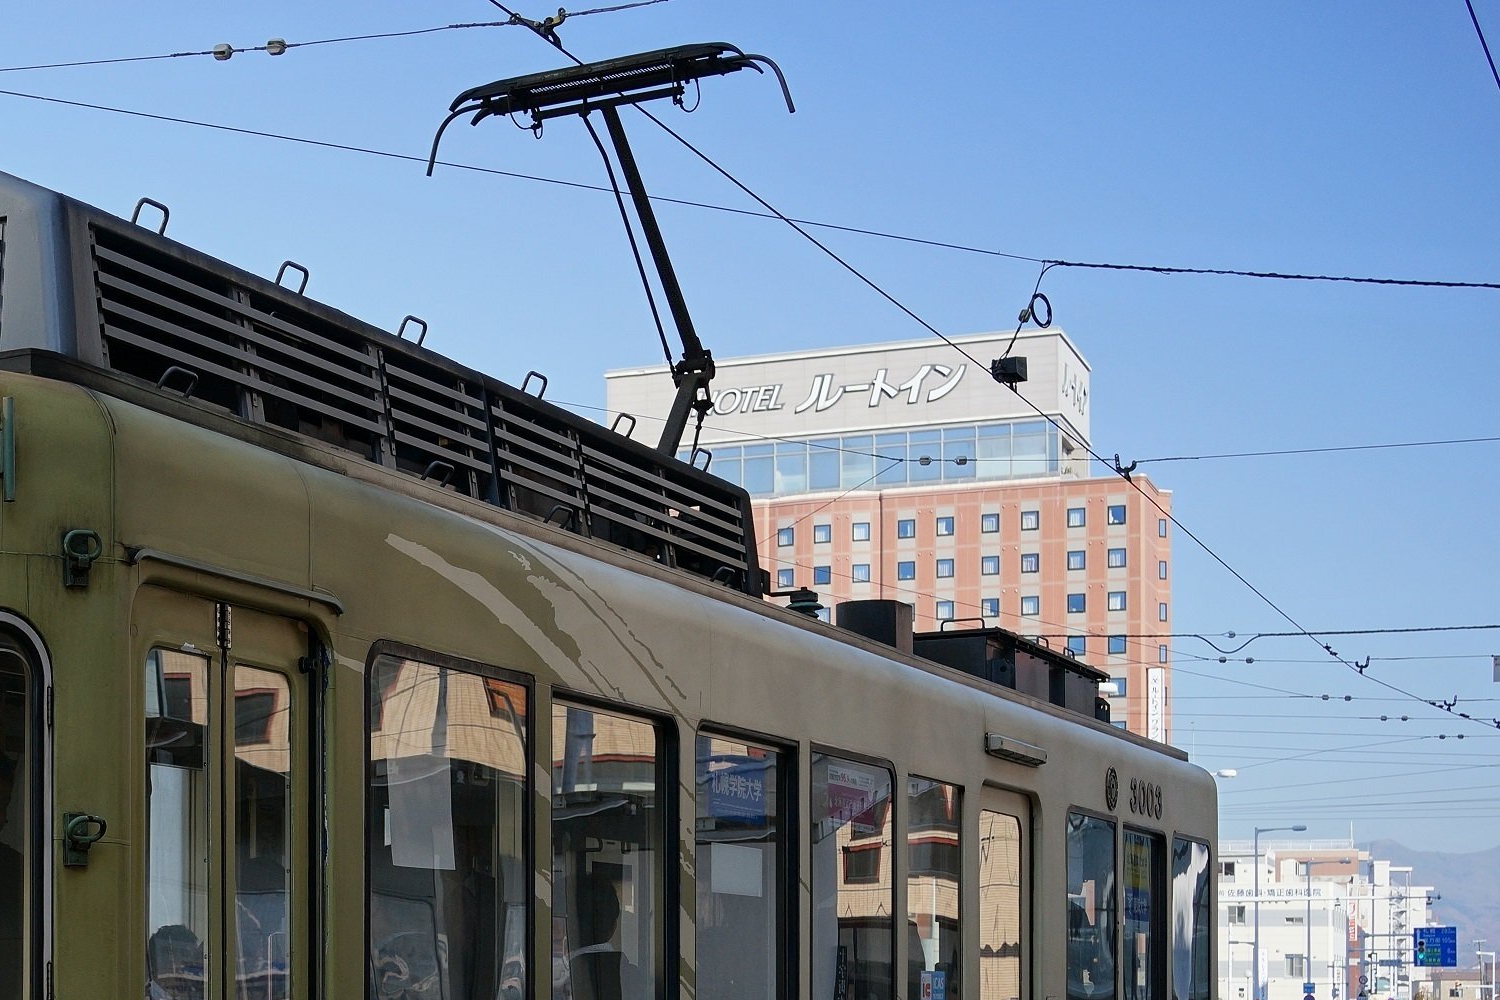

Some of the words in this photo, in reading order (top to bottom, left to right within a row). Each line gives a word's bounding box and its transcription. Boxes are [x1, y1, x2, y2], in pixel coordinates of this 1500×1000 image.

[794, 364, 967, 414] ルートイン
[1129, 776, 1162, 820] 3003
